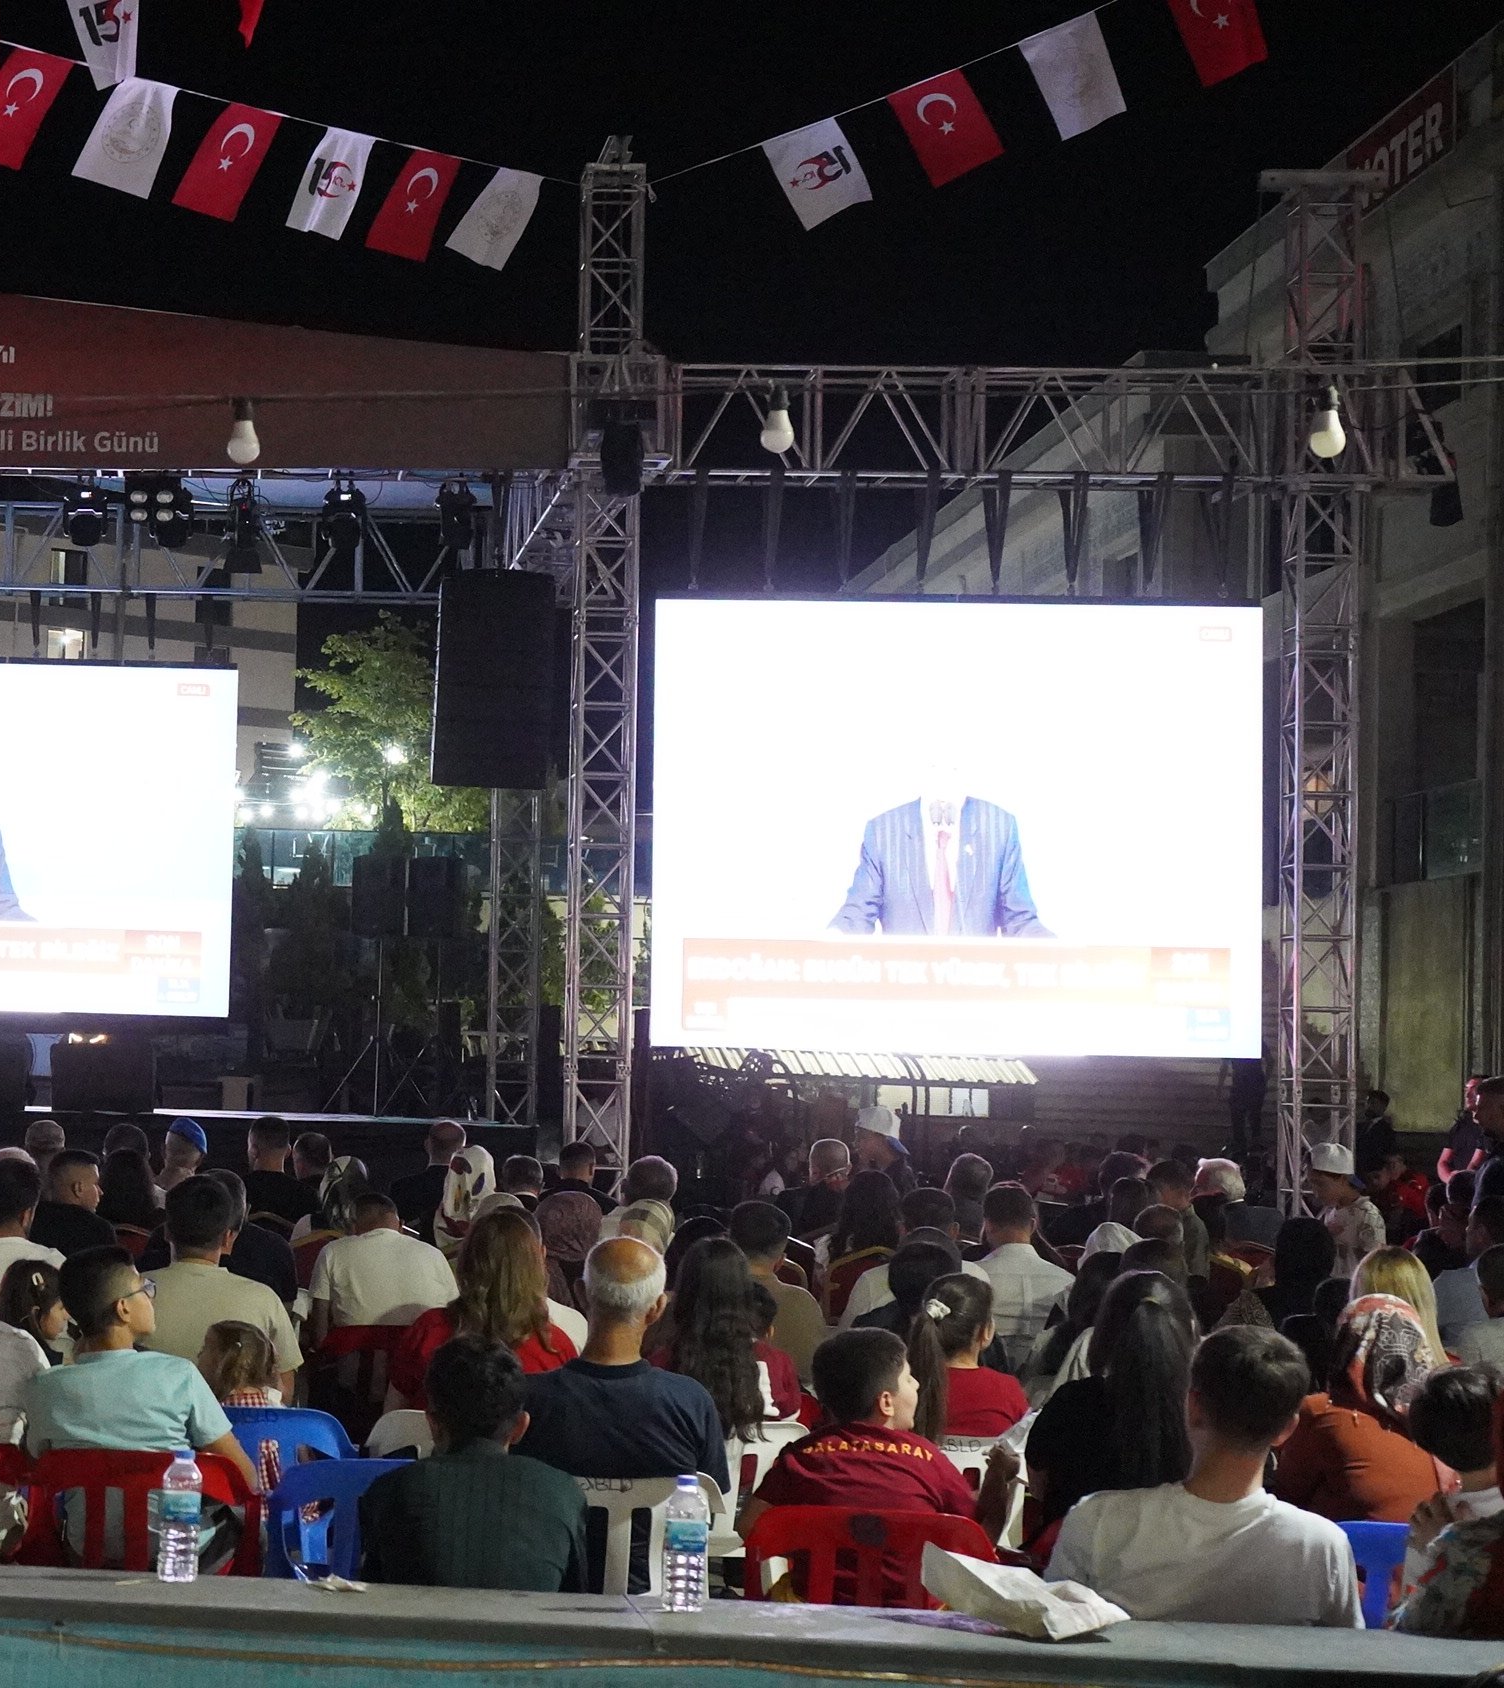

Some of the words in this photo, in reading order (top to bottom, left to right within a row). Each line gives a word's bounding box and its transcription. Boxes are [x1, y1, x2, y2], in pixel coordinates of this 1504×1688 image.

[1356, 101, 1444, 209] OTER
[22, 430, 86, 452] Birlik
[93, 431, 159, 453] Günü
